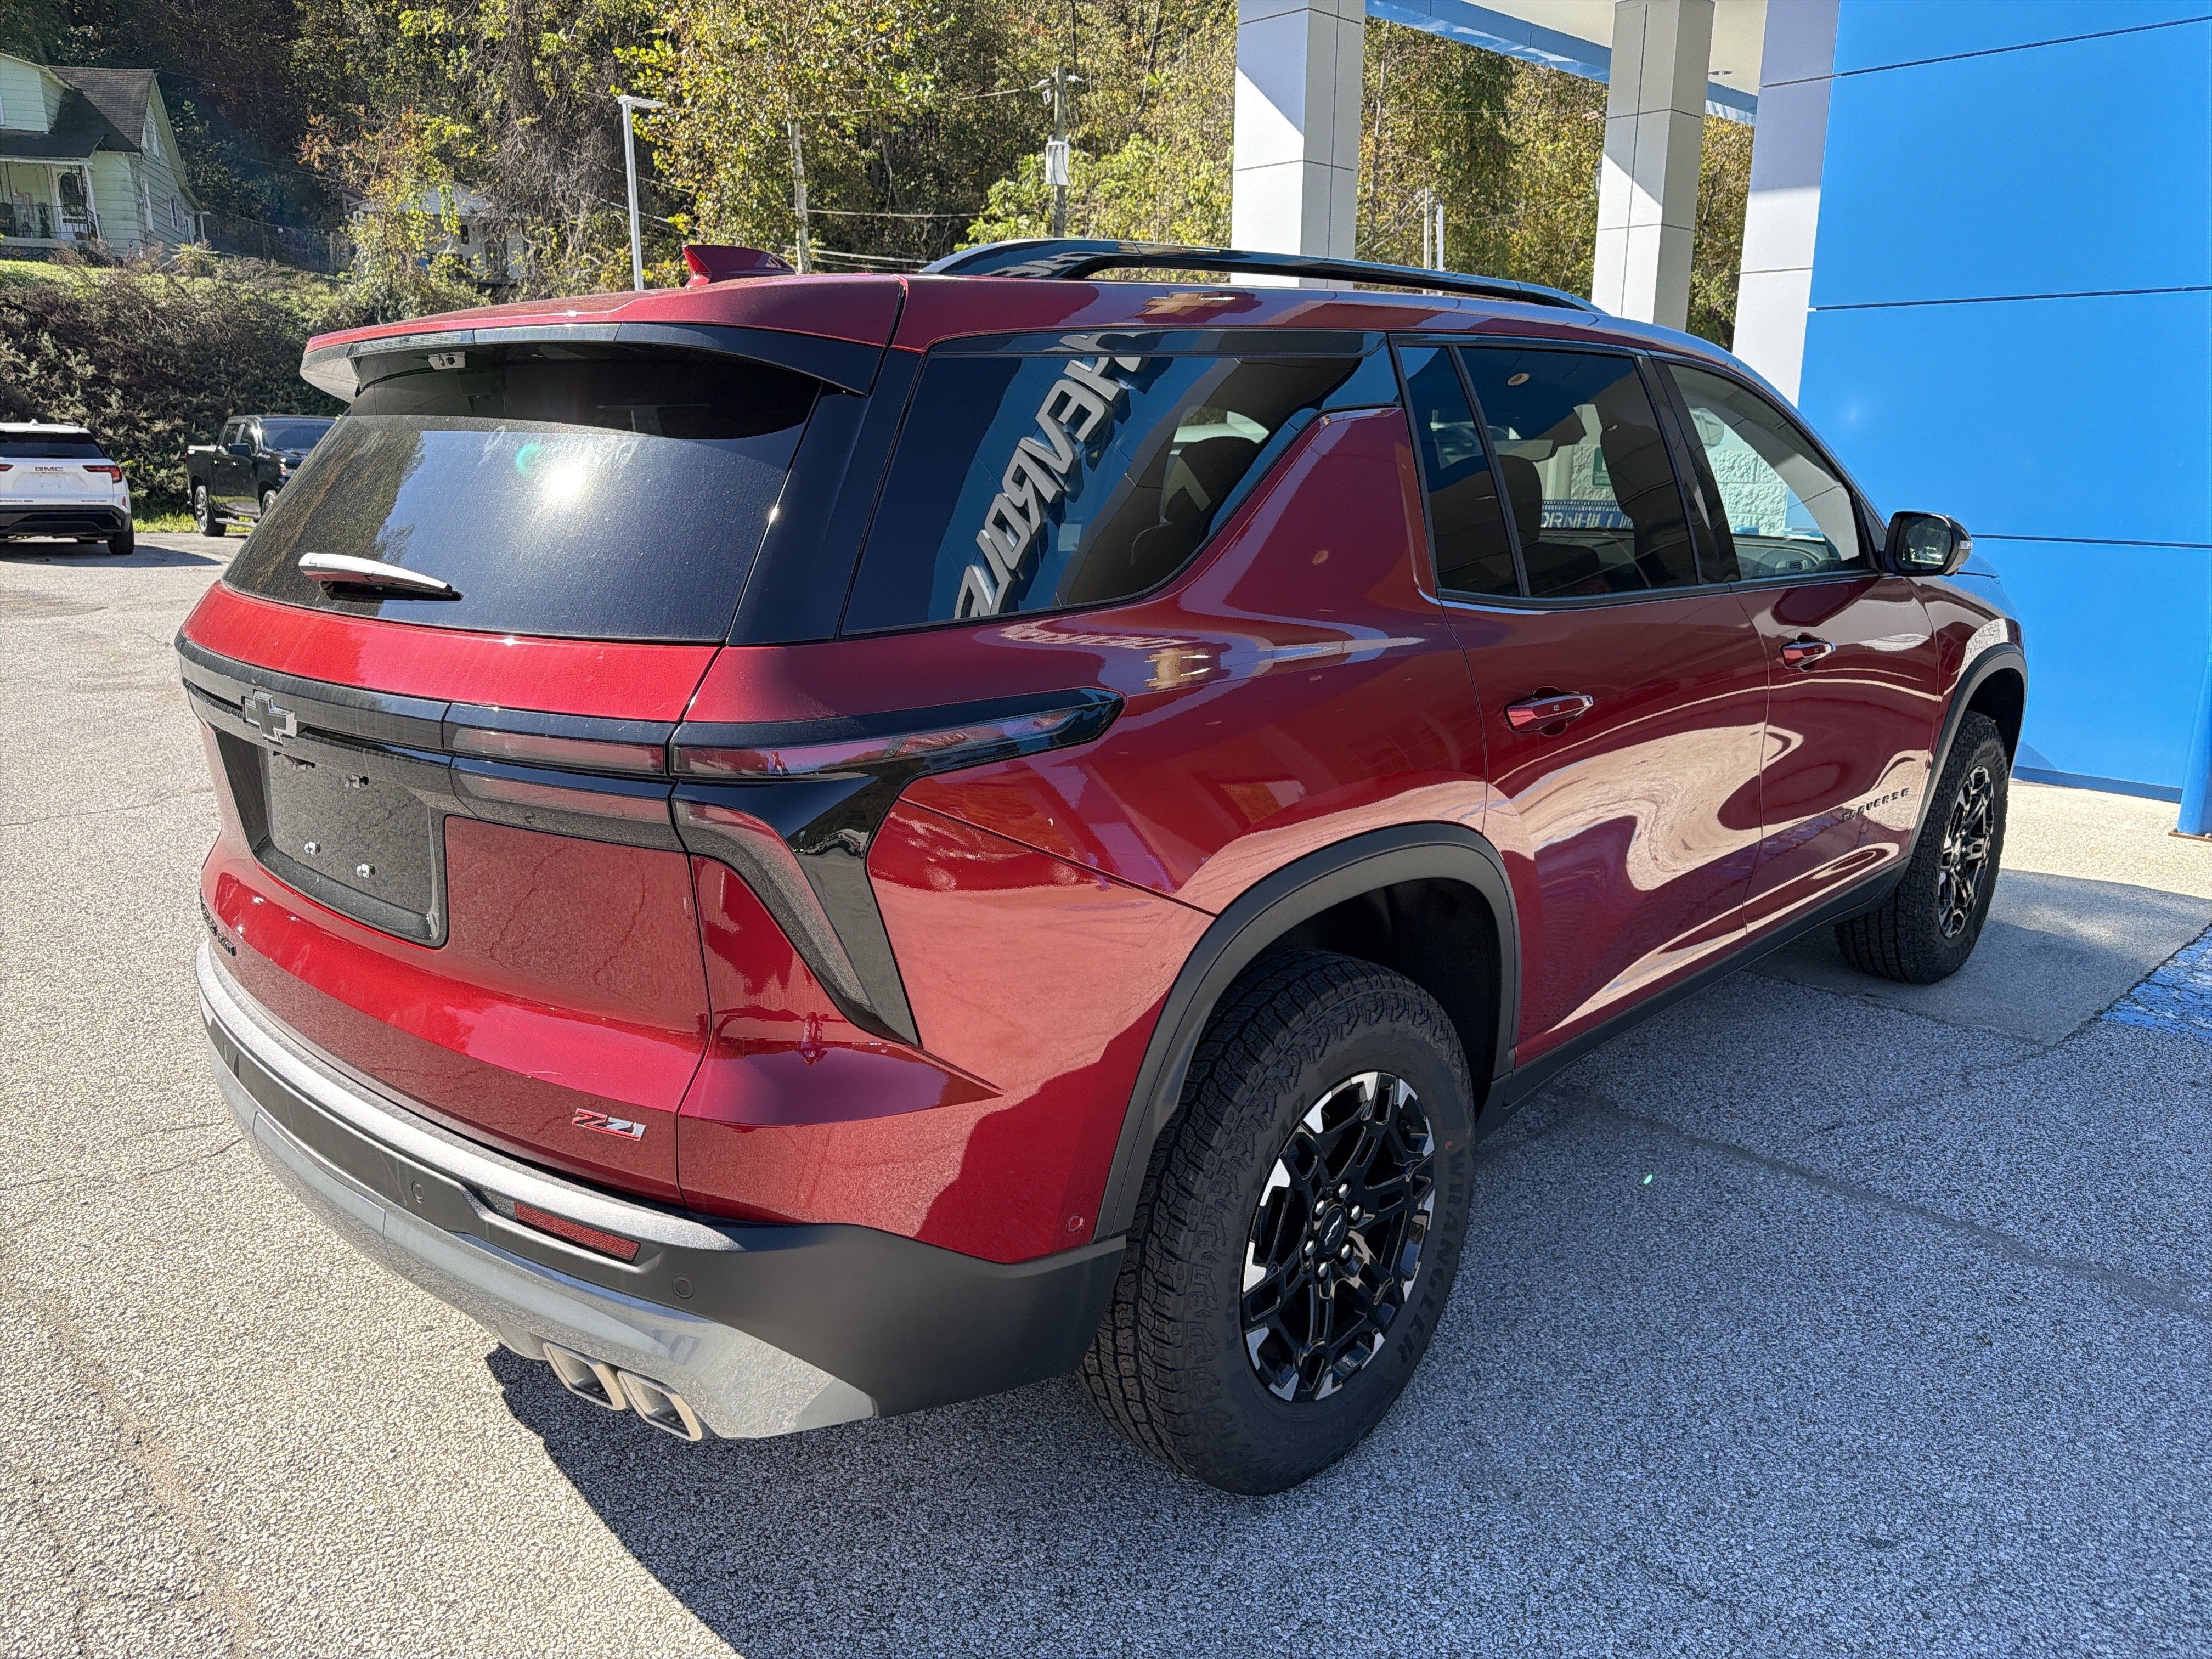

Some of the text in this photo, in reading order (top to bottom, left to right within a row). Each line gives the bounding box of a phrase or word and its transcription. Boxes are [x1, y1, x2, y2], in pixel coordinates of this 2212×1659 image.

[1841, 788, 1910, 822] TRAVERSE
[572, 1108, 647, 1141] Z71
[1397, 1146, 1466, 1365] WRANGLER
